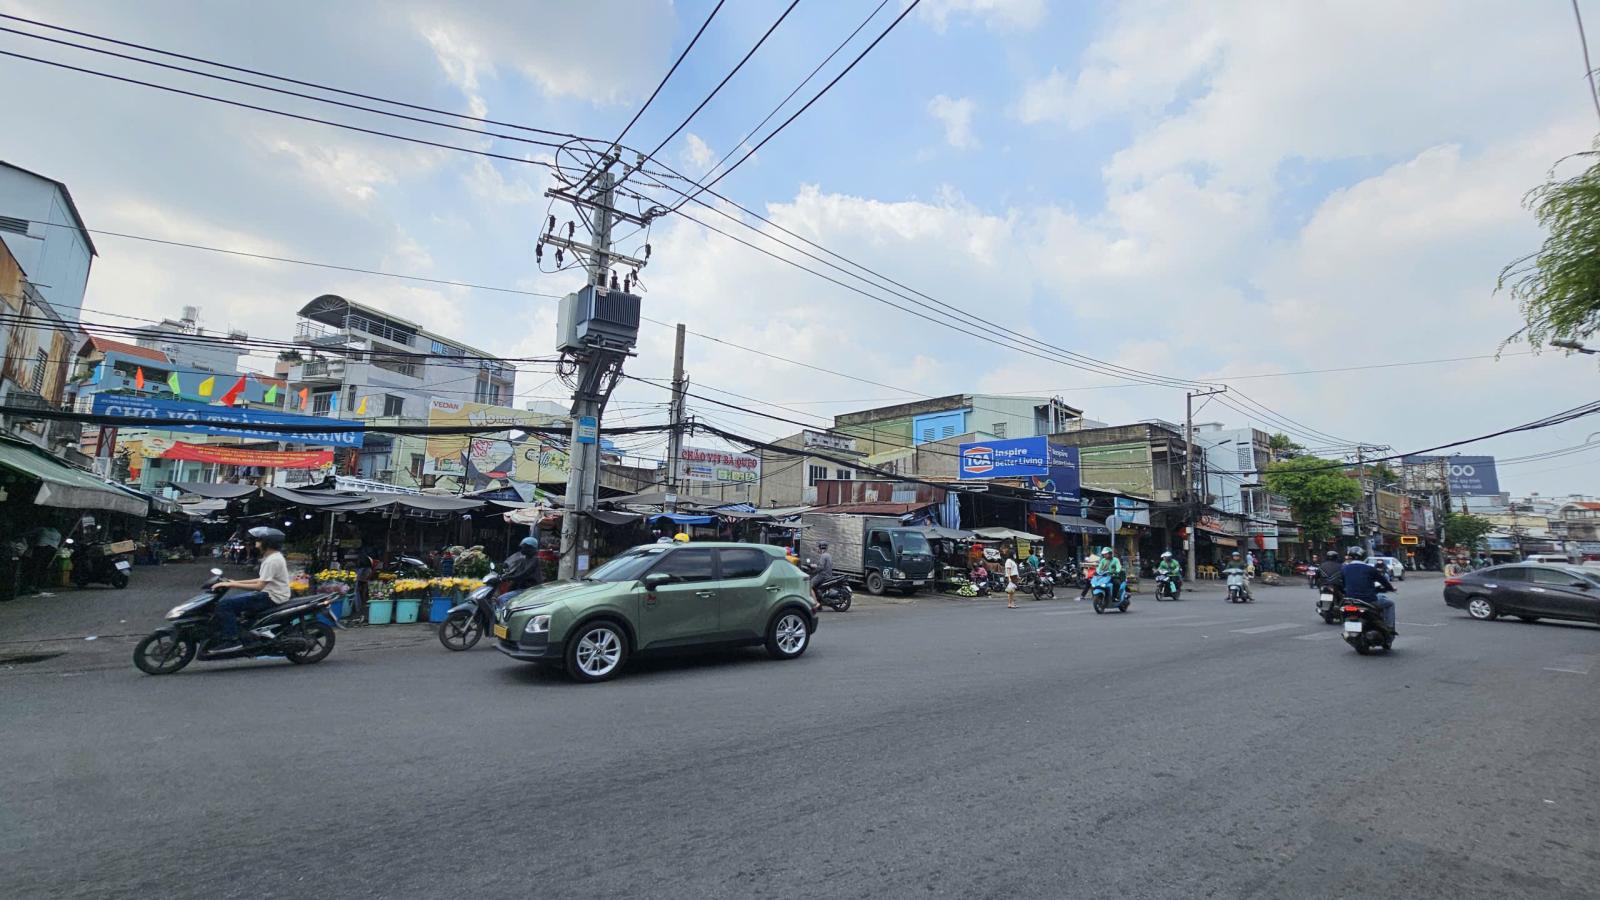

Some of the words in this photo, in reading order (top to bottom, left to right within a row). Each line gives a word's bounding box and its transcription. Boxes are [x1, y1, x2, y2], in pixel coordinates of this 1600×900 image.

[432, 400, 460, 410] VEDAN
[966, 454, 991, 466] TOA
[995, 447, 1028, 458] Inspire
[1019, 457, 1043, 466] Living
